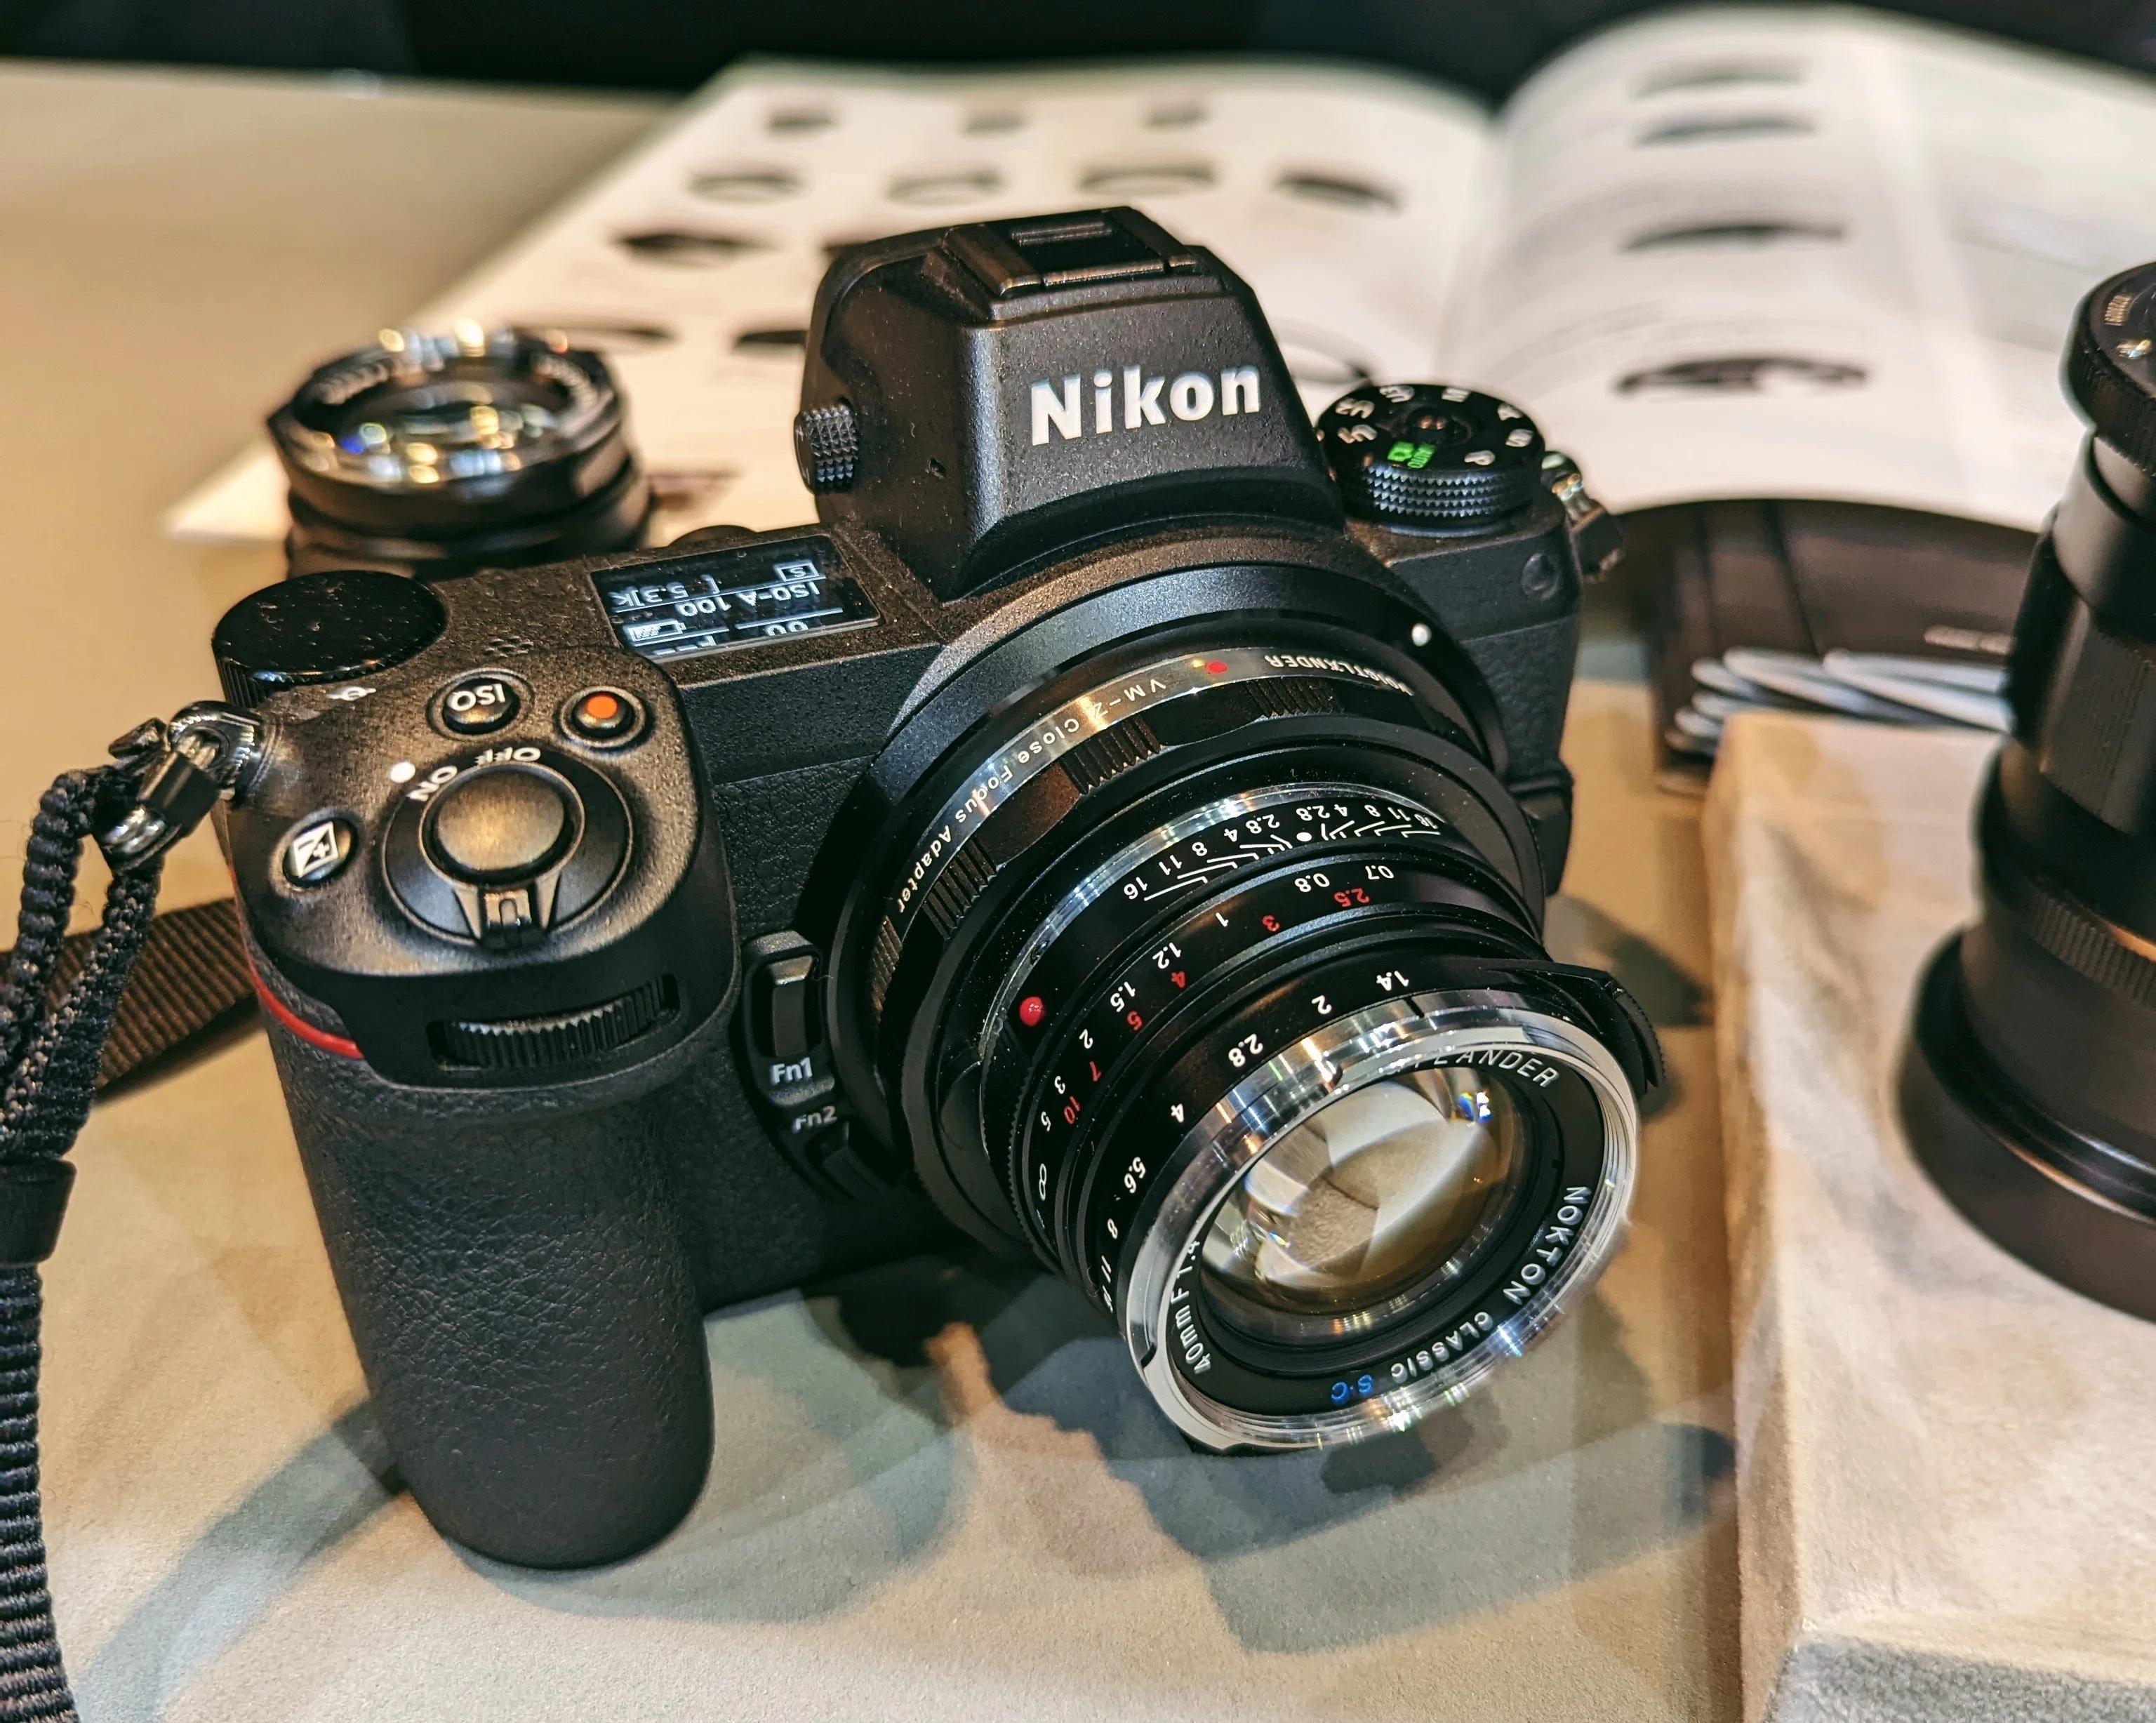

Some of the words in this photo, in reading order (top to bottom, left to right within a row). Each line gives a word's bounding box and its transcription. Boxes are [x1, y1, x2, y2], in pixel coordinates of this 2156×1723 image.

[1031, 364, 1260, 446] Nikon
[737, 581, 820, 606] ISO-A
[675, 597, 731, 617] 100
[447, 684, 506, 712] ISO
[1017, 719, 1080, 764] Close
[474, 746, 541, 766] OFF
[406, 765, 458, 801] ON
[954, 765, 1013, 824] Focus
[1296, 804, 1330, 821] 2.8
[1334, 804, 1348, 816] 4
[1364, 804, 1380, 818] 8
[1388, 806, 1411, 821] 11
[1246, 814, 1280, 833] 2.8
[1223, 829, 1238, 842] 4
[1192, 842, 1208, 856] 8
[896, 826, 952, 913] Adapter
[1159, 855, 1183, 876] 11
[1364, 865, 1395, 880] 0.7
[1123, 876, 1148, 900] 16
[1294, 873, 1330, 893] 0.8
[1333, 888, 1371, 907] 2.5
[1216, 912, 1229, 928] 1
[1263, 915, 1280, 932] 3
[1152, 943, 1182, 969] 1.2
[1171, 971, 1186, 988] 4
[1376, 970, 1410, 991] 1.4
[1110, 981, 1136, 1013] 1.5
[1312, 995, 1333, 1015] 2
[1126, 1010, 1143, 1031] 5
[1079, 1029, 1094, 1050] 2
[1228, 1034, 1264, 1067] 2.8
[769, 1057, 813, 1085] Fn1
[1089, 1061, 1102, 1082] 7
[1054, 1076, 1065, 1095] 3
[792, 1105, 837, 1133] Fn2
[1063, 1096, 1081, 1124] 10
[1170, 1103, 1185, 1123] 4
[1041, 1111, 1051, 1131] 5
[1124, 1157, 1147, 1194] 5.6
[1107, 1218, 1118, 1240] 8
[1503, 1186, 1592, 1306] NOKTON
[1175, 1305, 1211, 1374] 40mm
[1390, 1311, 1493, 1385] CLASSIC
